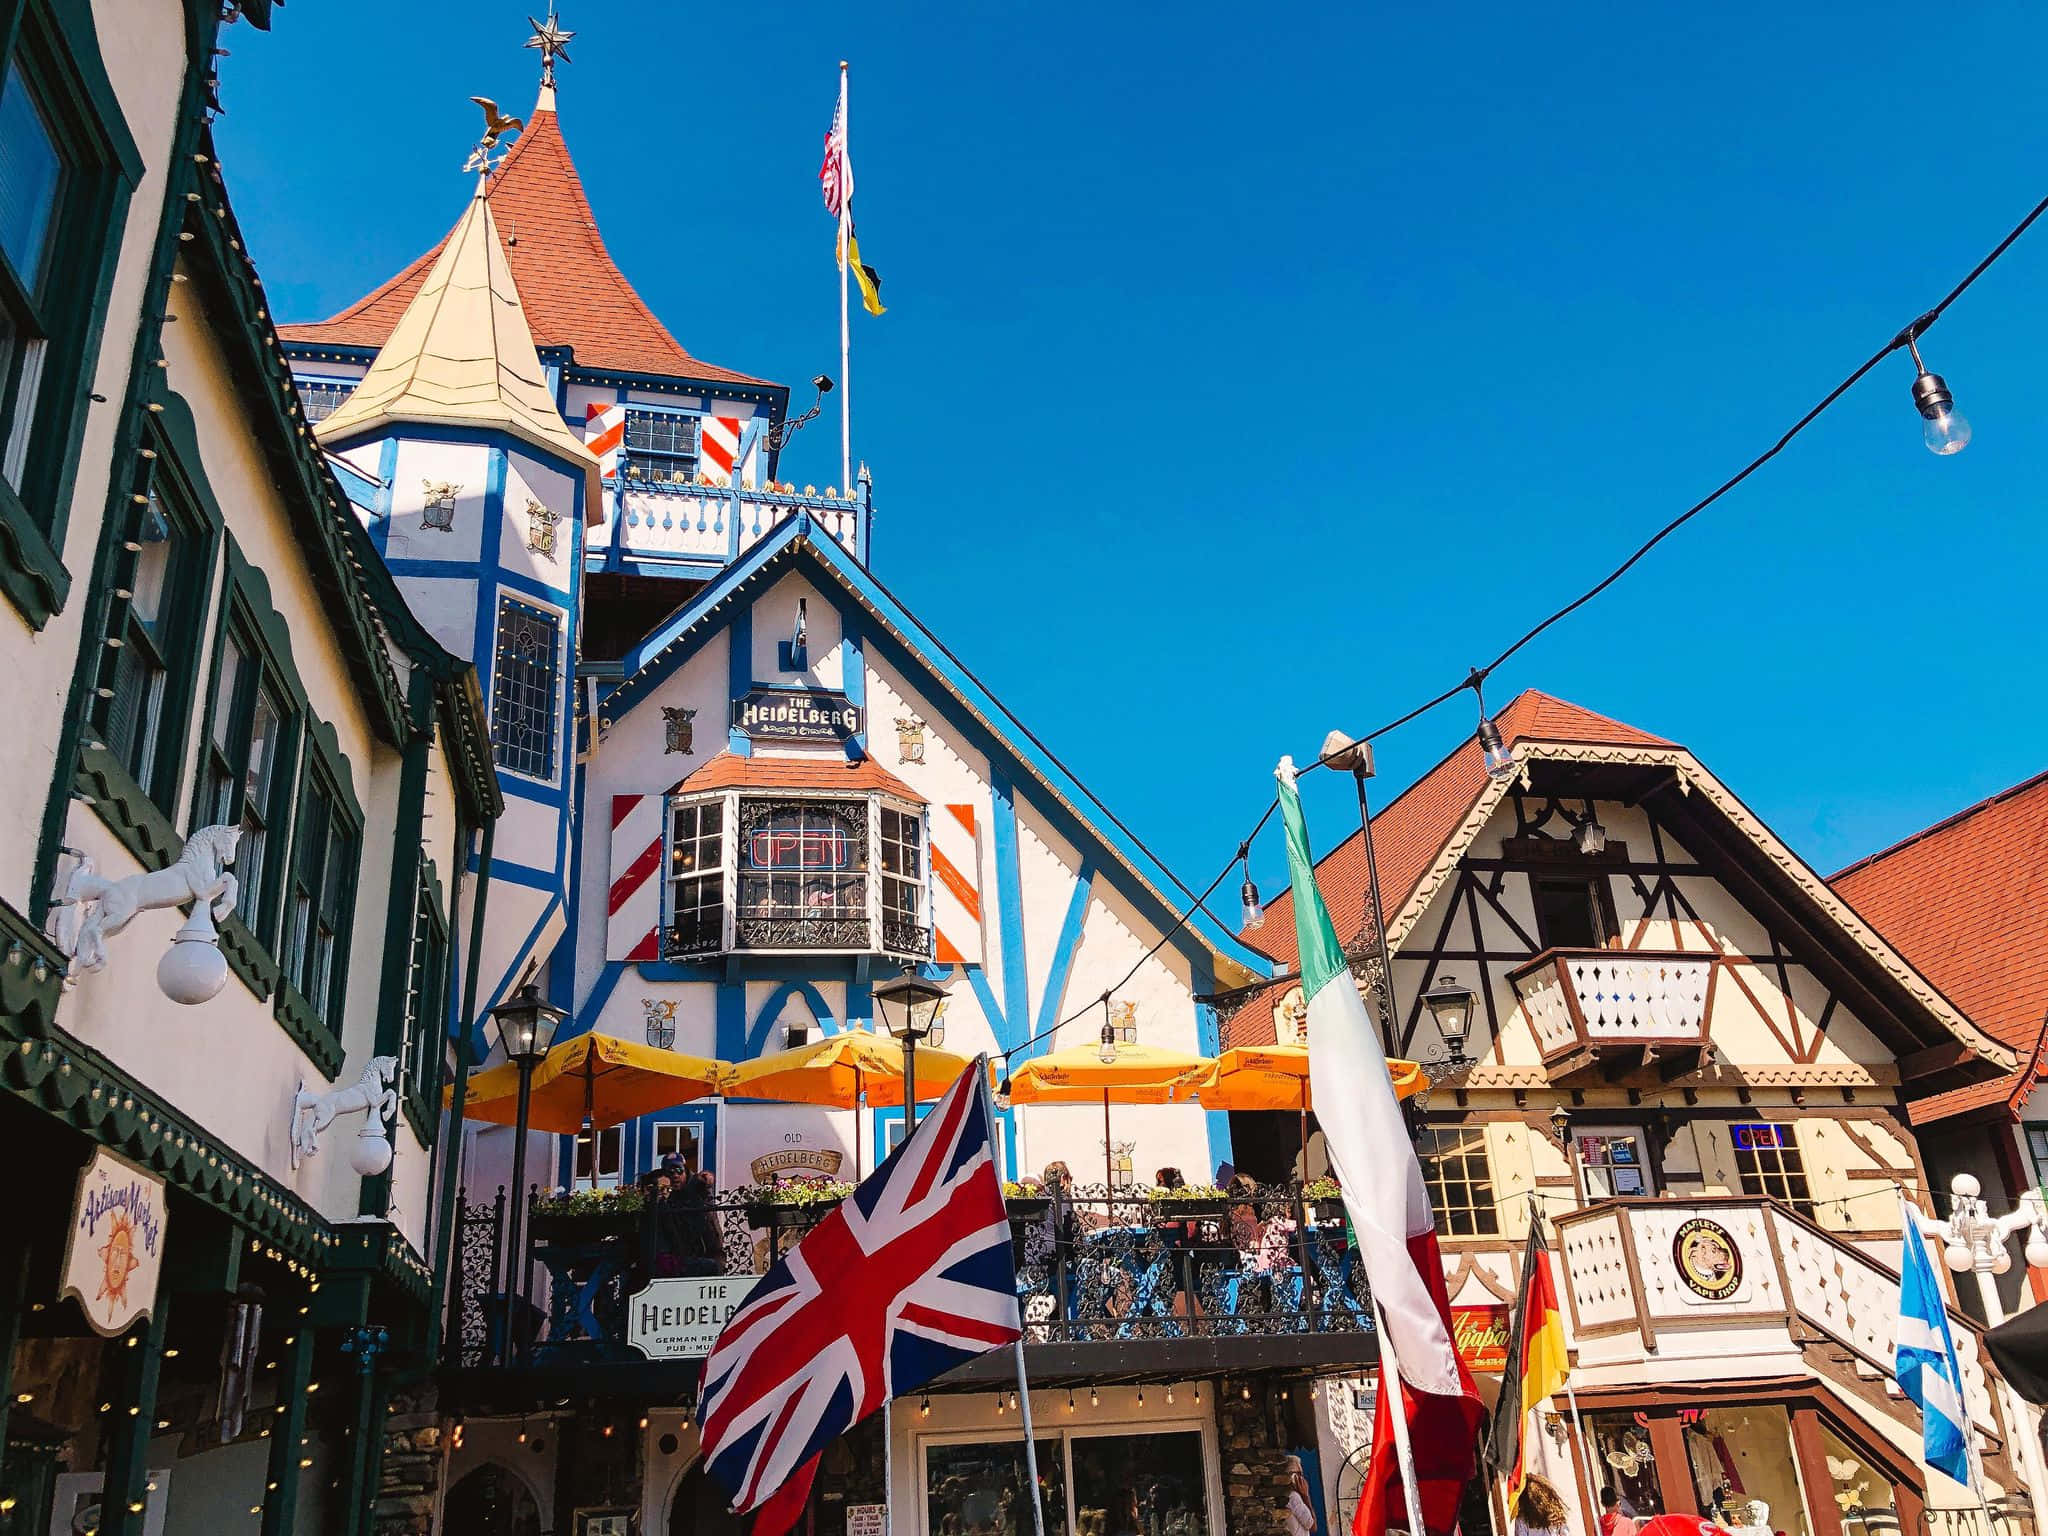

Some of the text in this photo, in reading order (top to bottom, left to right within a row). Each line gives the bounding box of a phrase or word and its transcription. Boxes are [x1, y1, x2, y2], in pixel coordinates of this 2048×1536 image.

[789, 698, 811, 708] THE
[742, 702, 857, 732] HEIDELBERG
[753, 833, 842, 865] OPEN
[784, 1133, 802, 1144] OLD
[1738, 1129, 1781, 1146] OPEN
[760, 1152, 831, 1169] HEIDELBERG
[1679, 1220, 1725, 1238] MARLEY'S
[700, 1286, 728, 1299] THE
[1689, 1276, 1739, 1299] VAPE SHOP
[655, 1336, 697, 1344] GERMAN
